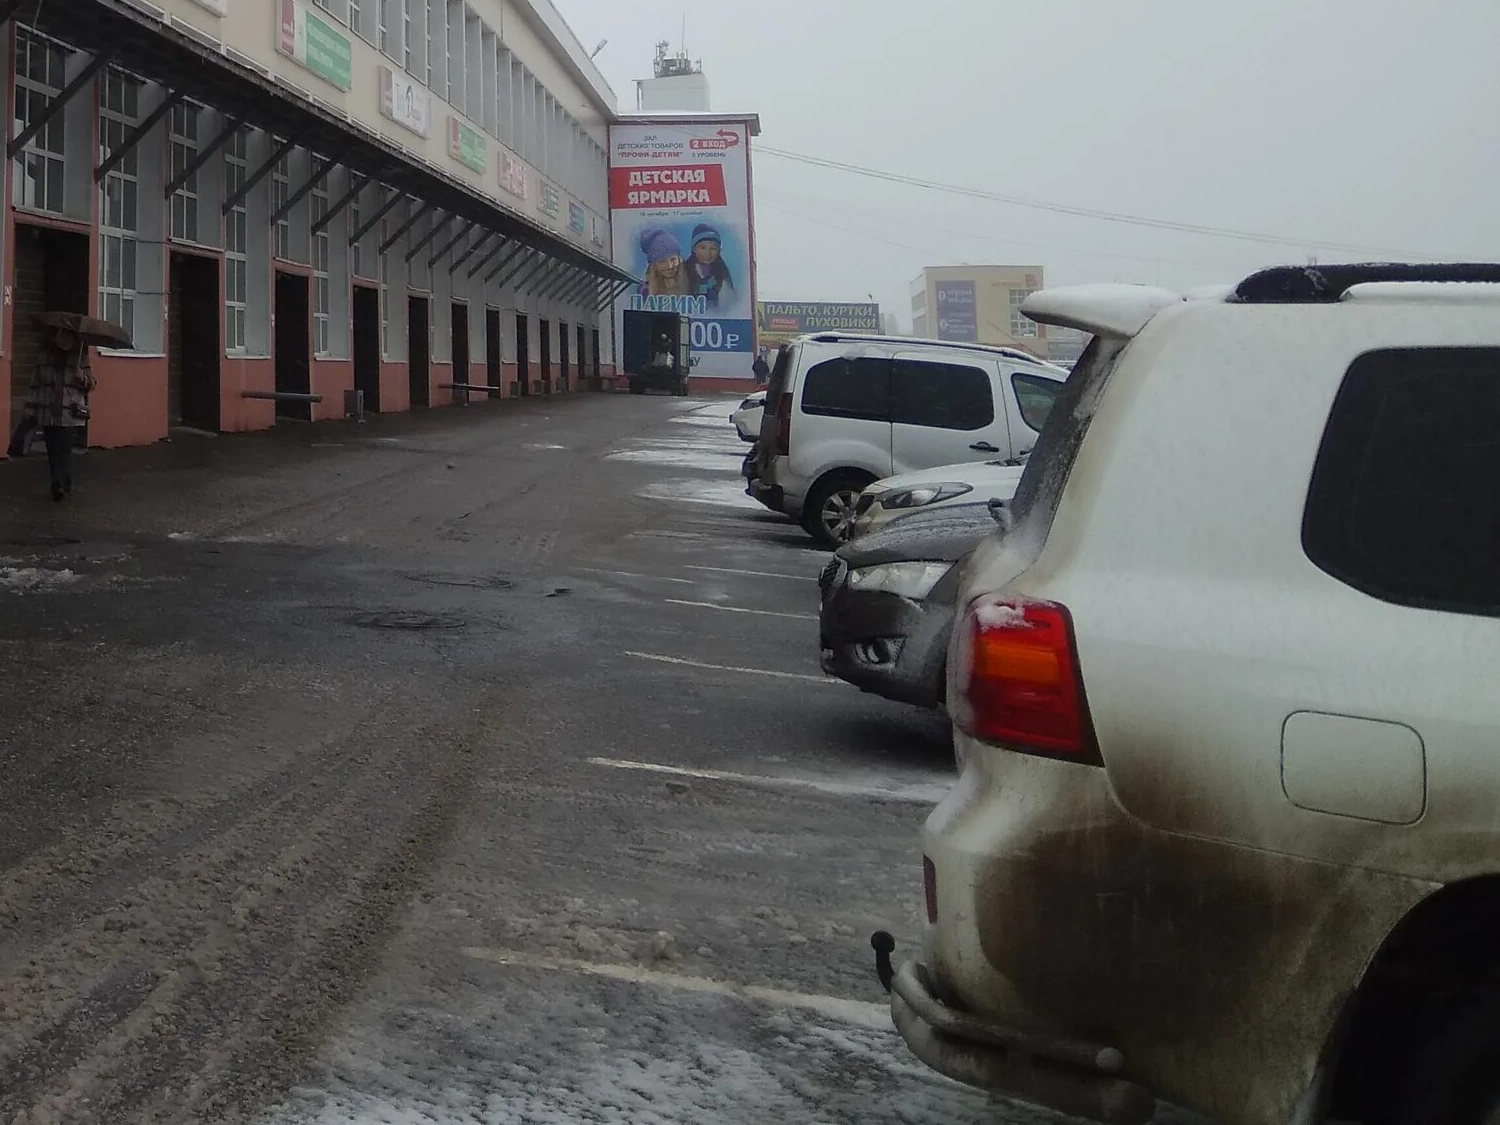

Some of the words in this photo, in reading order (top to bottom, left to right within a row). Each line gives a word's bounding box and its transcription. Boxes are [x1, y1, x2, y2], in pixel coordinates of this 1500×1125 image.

[692, 140, 699, 148] 2
[702, 140, 726, 149] ВХОД
[629, 169, 706, 186] ДЕТСКАЯ
[628, 189, 710, 204] ЯРМАРКА
[766, 304, 821, 316] ПАЛЬТО,
[823, 305, 877, 317] КУРТКИ,
[805, 317, 877, 328] ПУХОВИКИ
